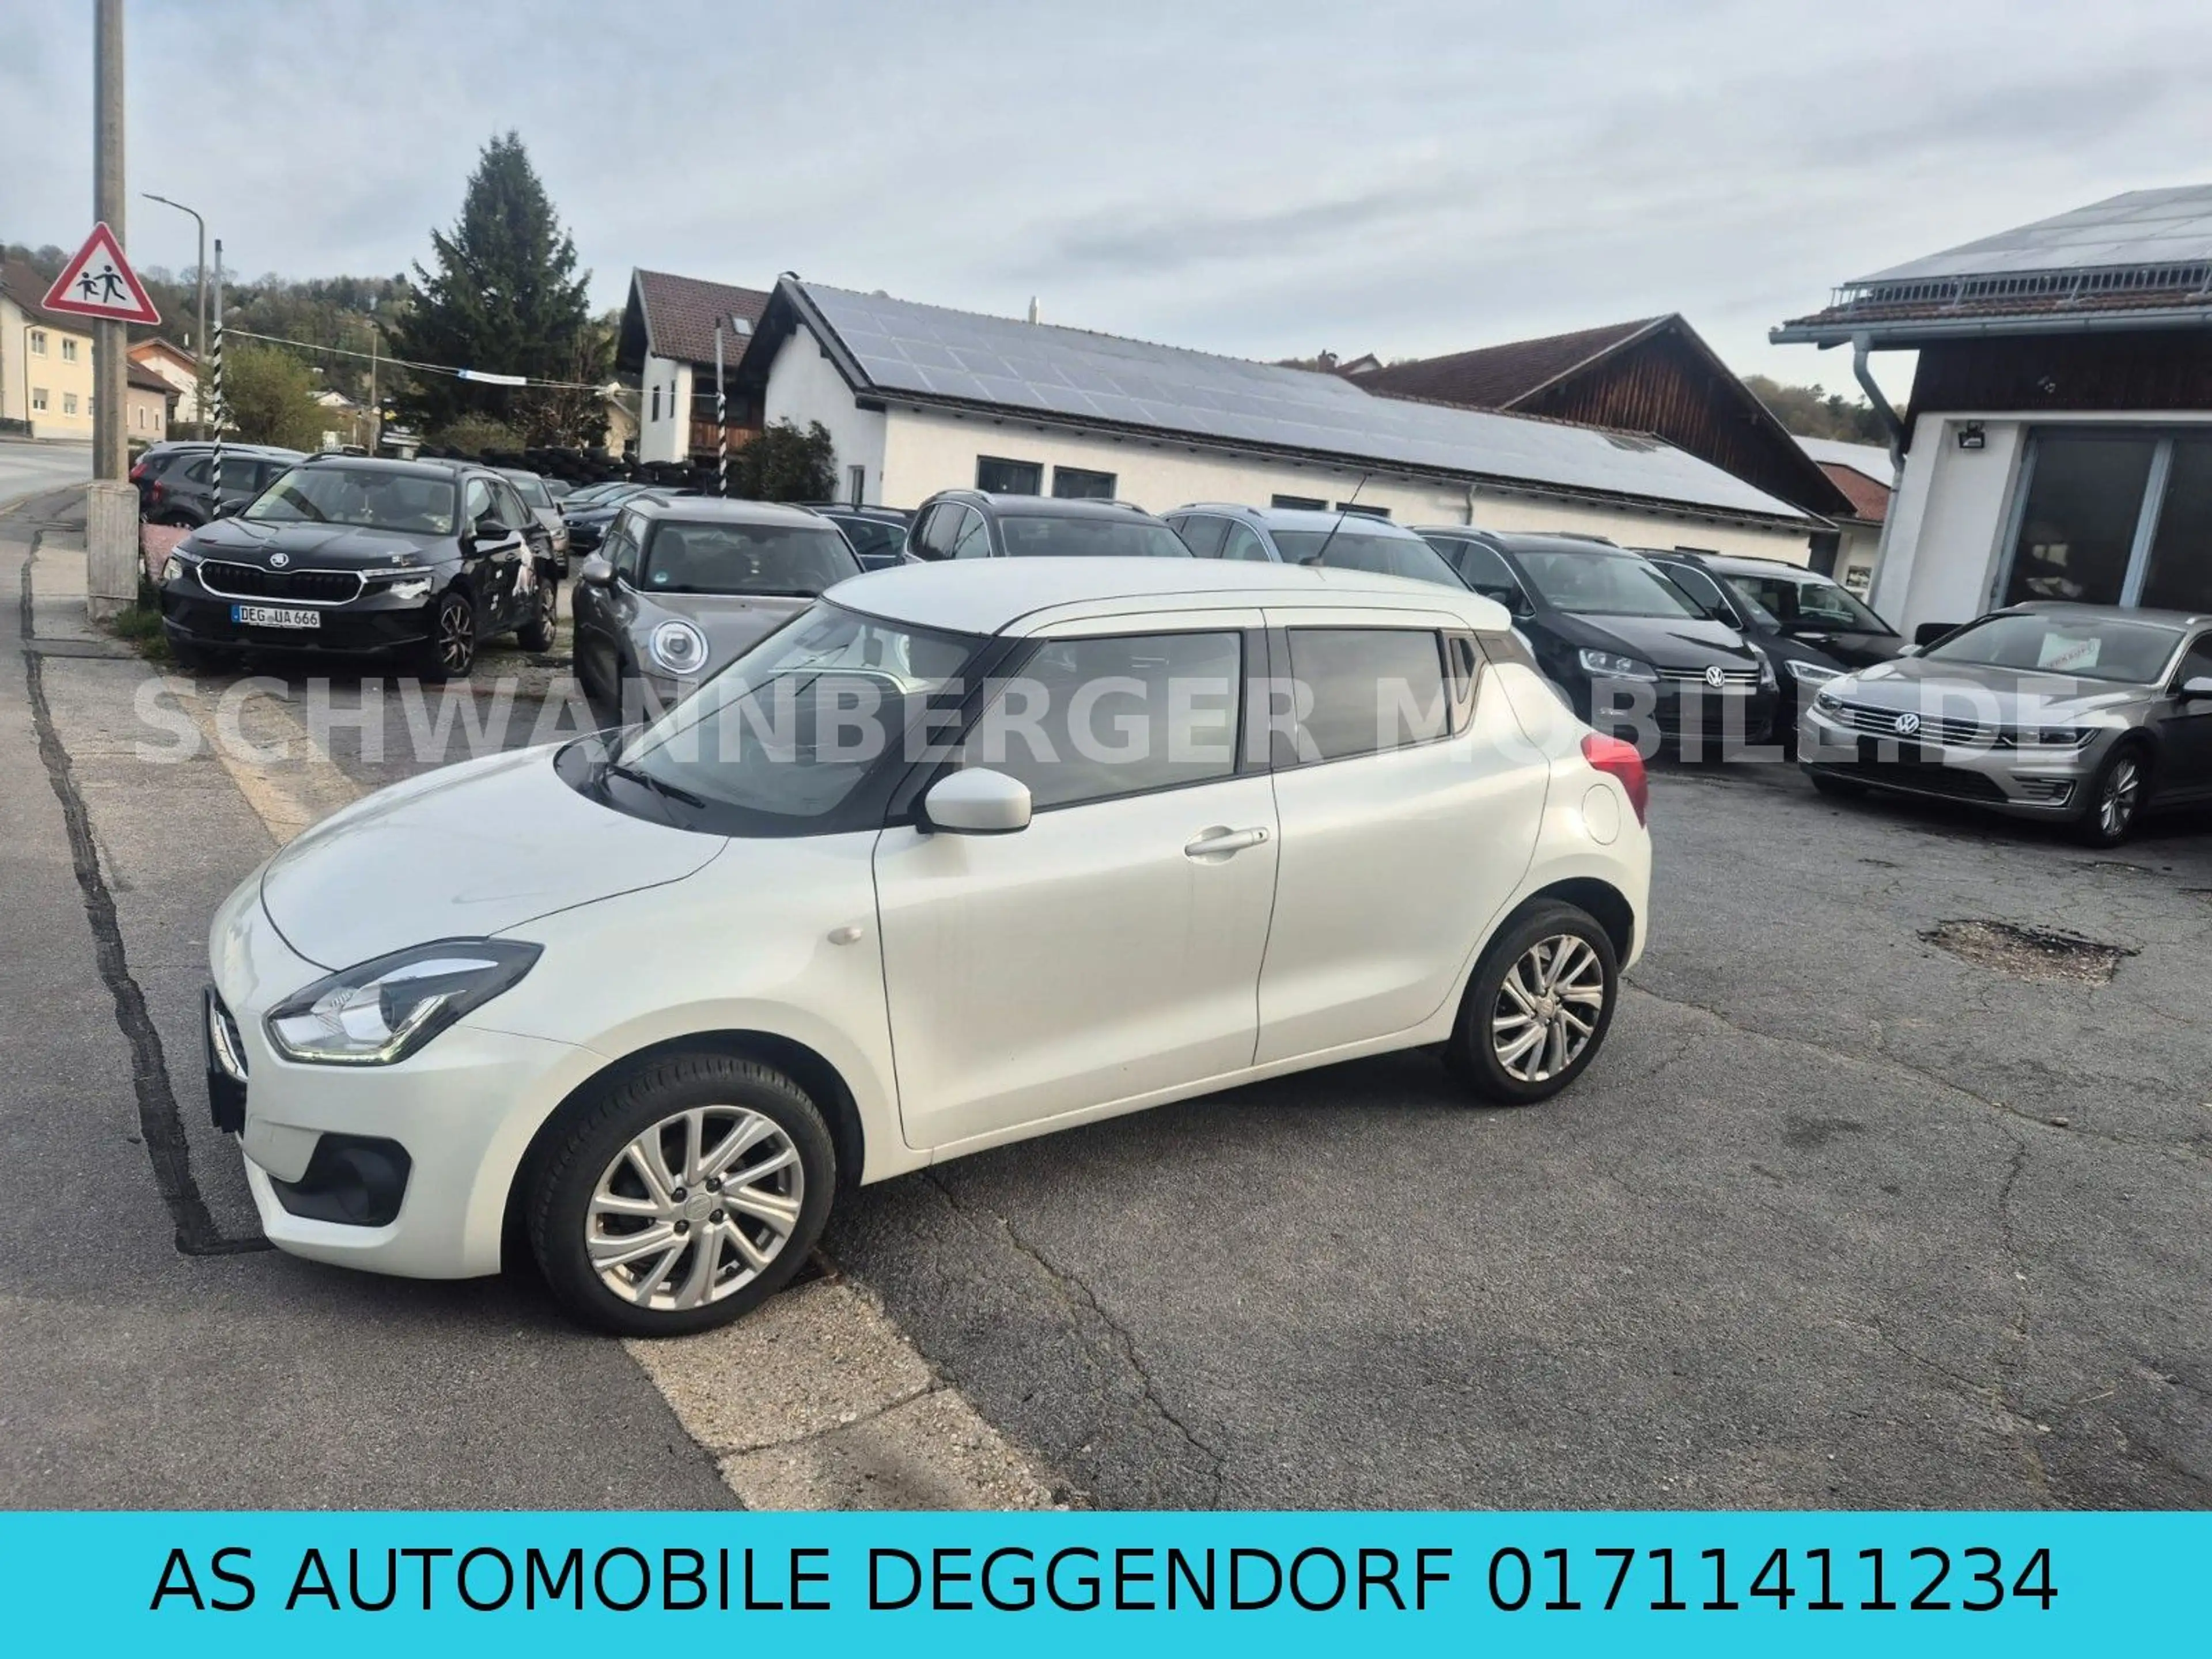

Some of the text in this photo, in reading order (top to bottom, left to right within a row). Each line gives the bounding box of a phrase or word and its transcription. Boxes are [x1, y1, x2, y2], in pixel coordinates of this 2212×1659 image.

[241, 608, 317, 625] DEG UA 666
